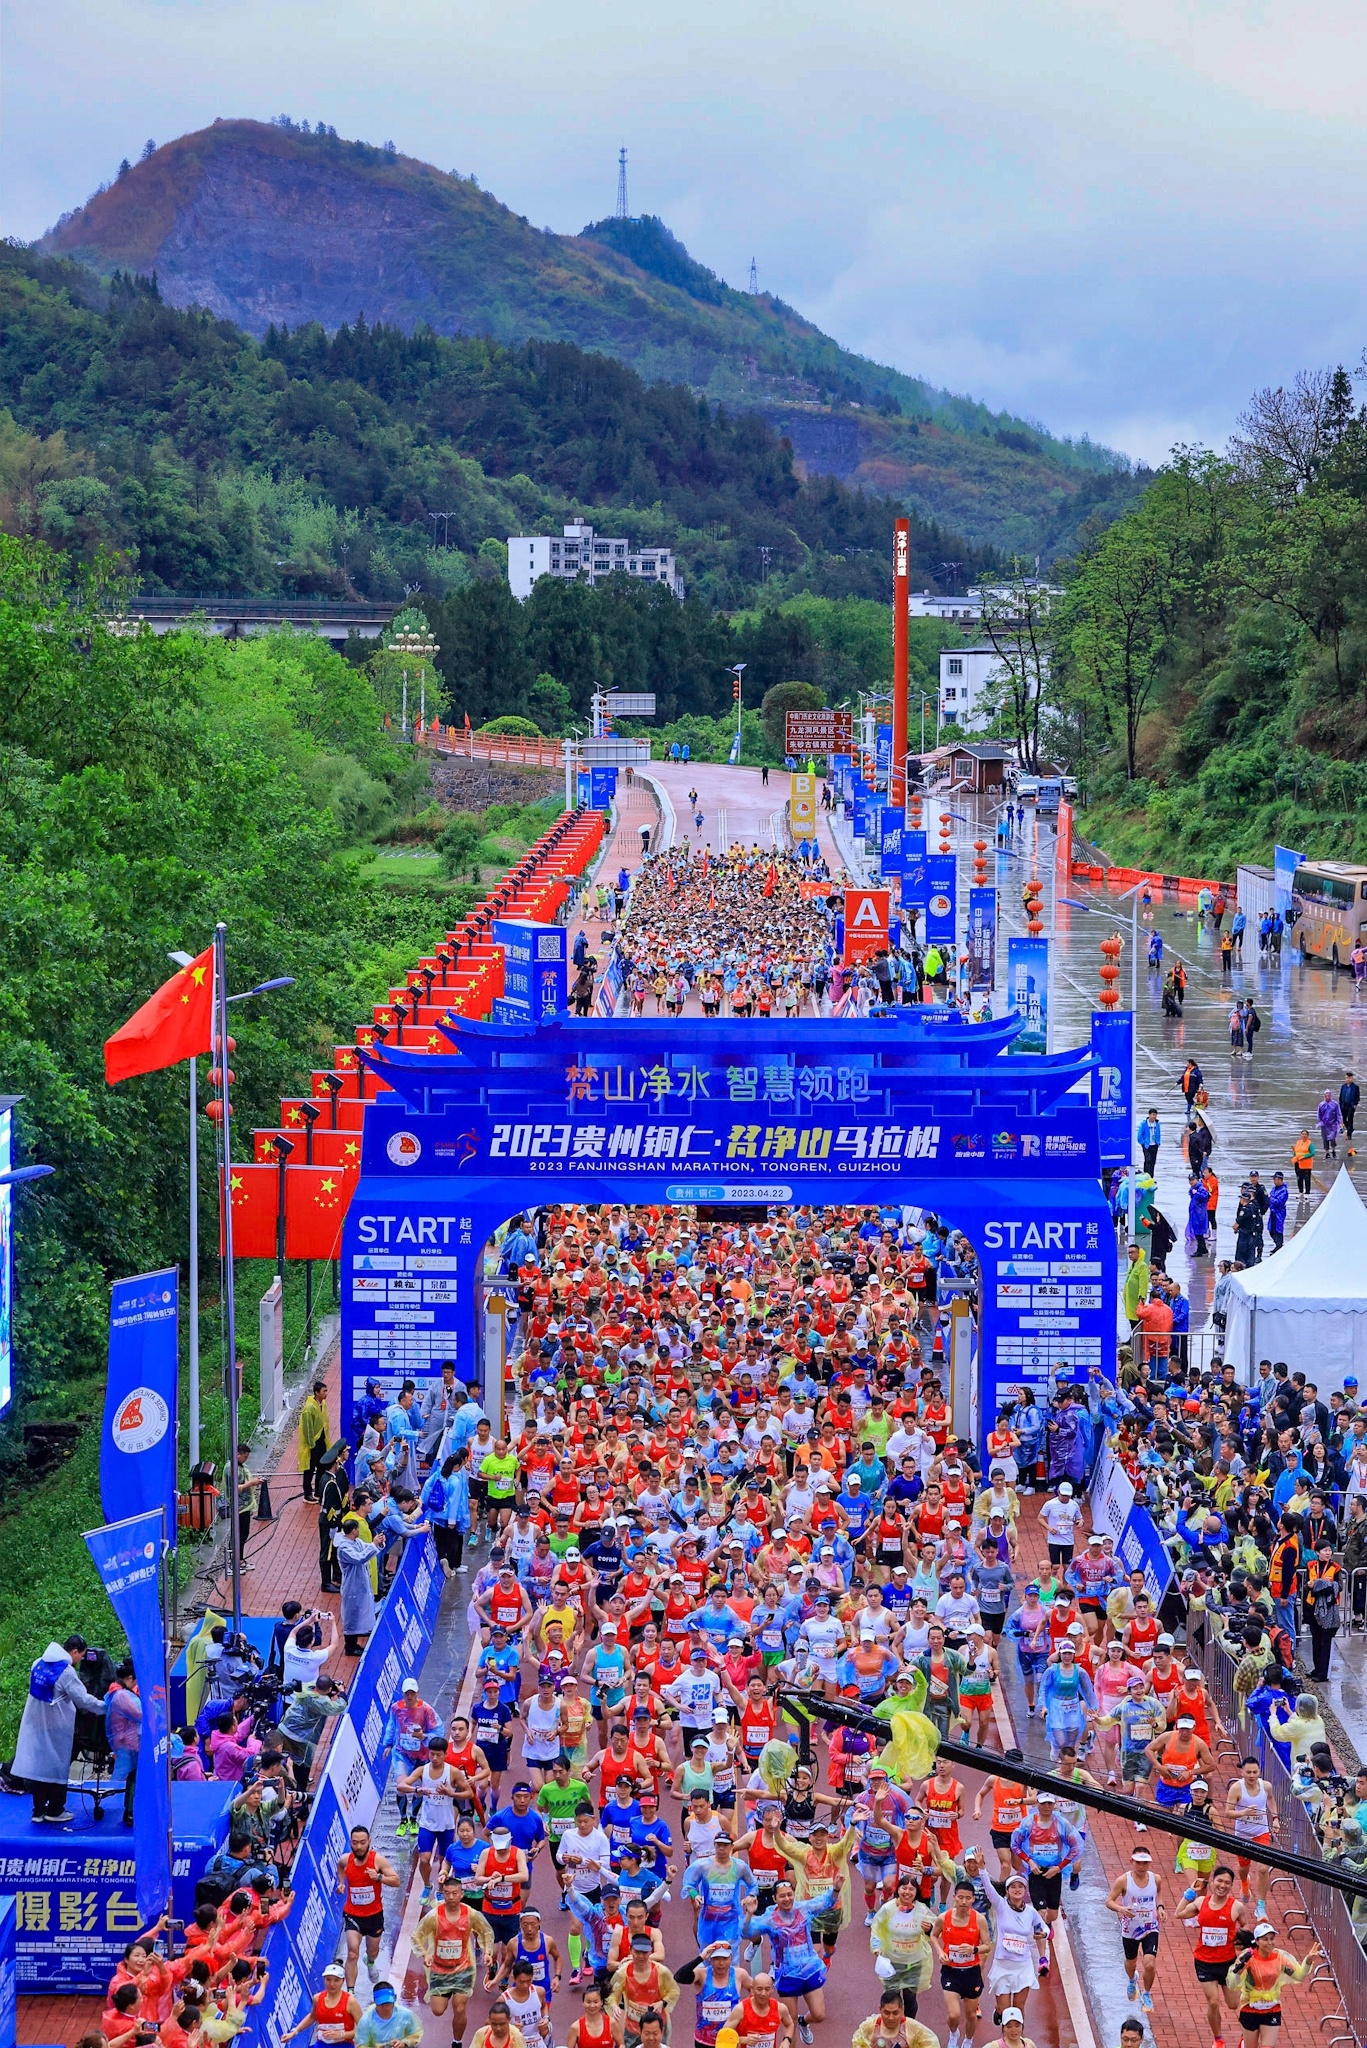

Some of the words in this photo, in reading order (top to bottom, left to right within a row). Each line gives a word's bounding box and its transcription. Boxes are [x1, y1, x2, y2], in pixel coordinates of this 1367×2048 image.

[796, 776, 810, 792] B
[853, 898, 882, 926] A
[974, 908, 982, 958] 中国马拉松
[1015, 964, 1028, 1016] 跑遍中国
[1028, 992, 1041, 1032] 贵州站
[565, 1064, 710, 1102] 梵山净水
[726, 1065, 870, 1102] 智慧领跑
[490, 1124, 940, 1158] 2023贵州铜仁·梵净山马拉松
[530, 1162, 563, 1171] 2023
[568, 1162, 666, 1171] FANJINGSHAN
[672, 1162, 754, 1173] MARATHON,
[760, 1162, 832, 1173] TONGREN,
[838, 1162, 901, 1172] GUIZHOU
[675, 1189, 717, 1198] 贵州·铜仁
[358, 1216, 456, 1243] START
[460, 1217, 472, 1244] 起点
[984, 1222, 1082, 1248] START
[1086, 1222, 1098, 1248] 起点
[16, 1891, 144, 1931] 摄影台
[297, 1880, 326, 1974] 贵州省田径协会
